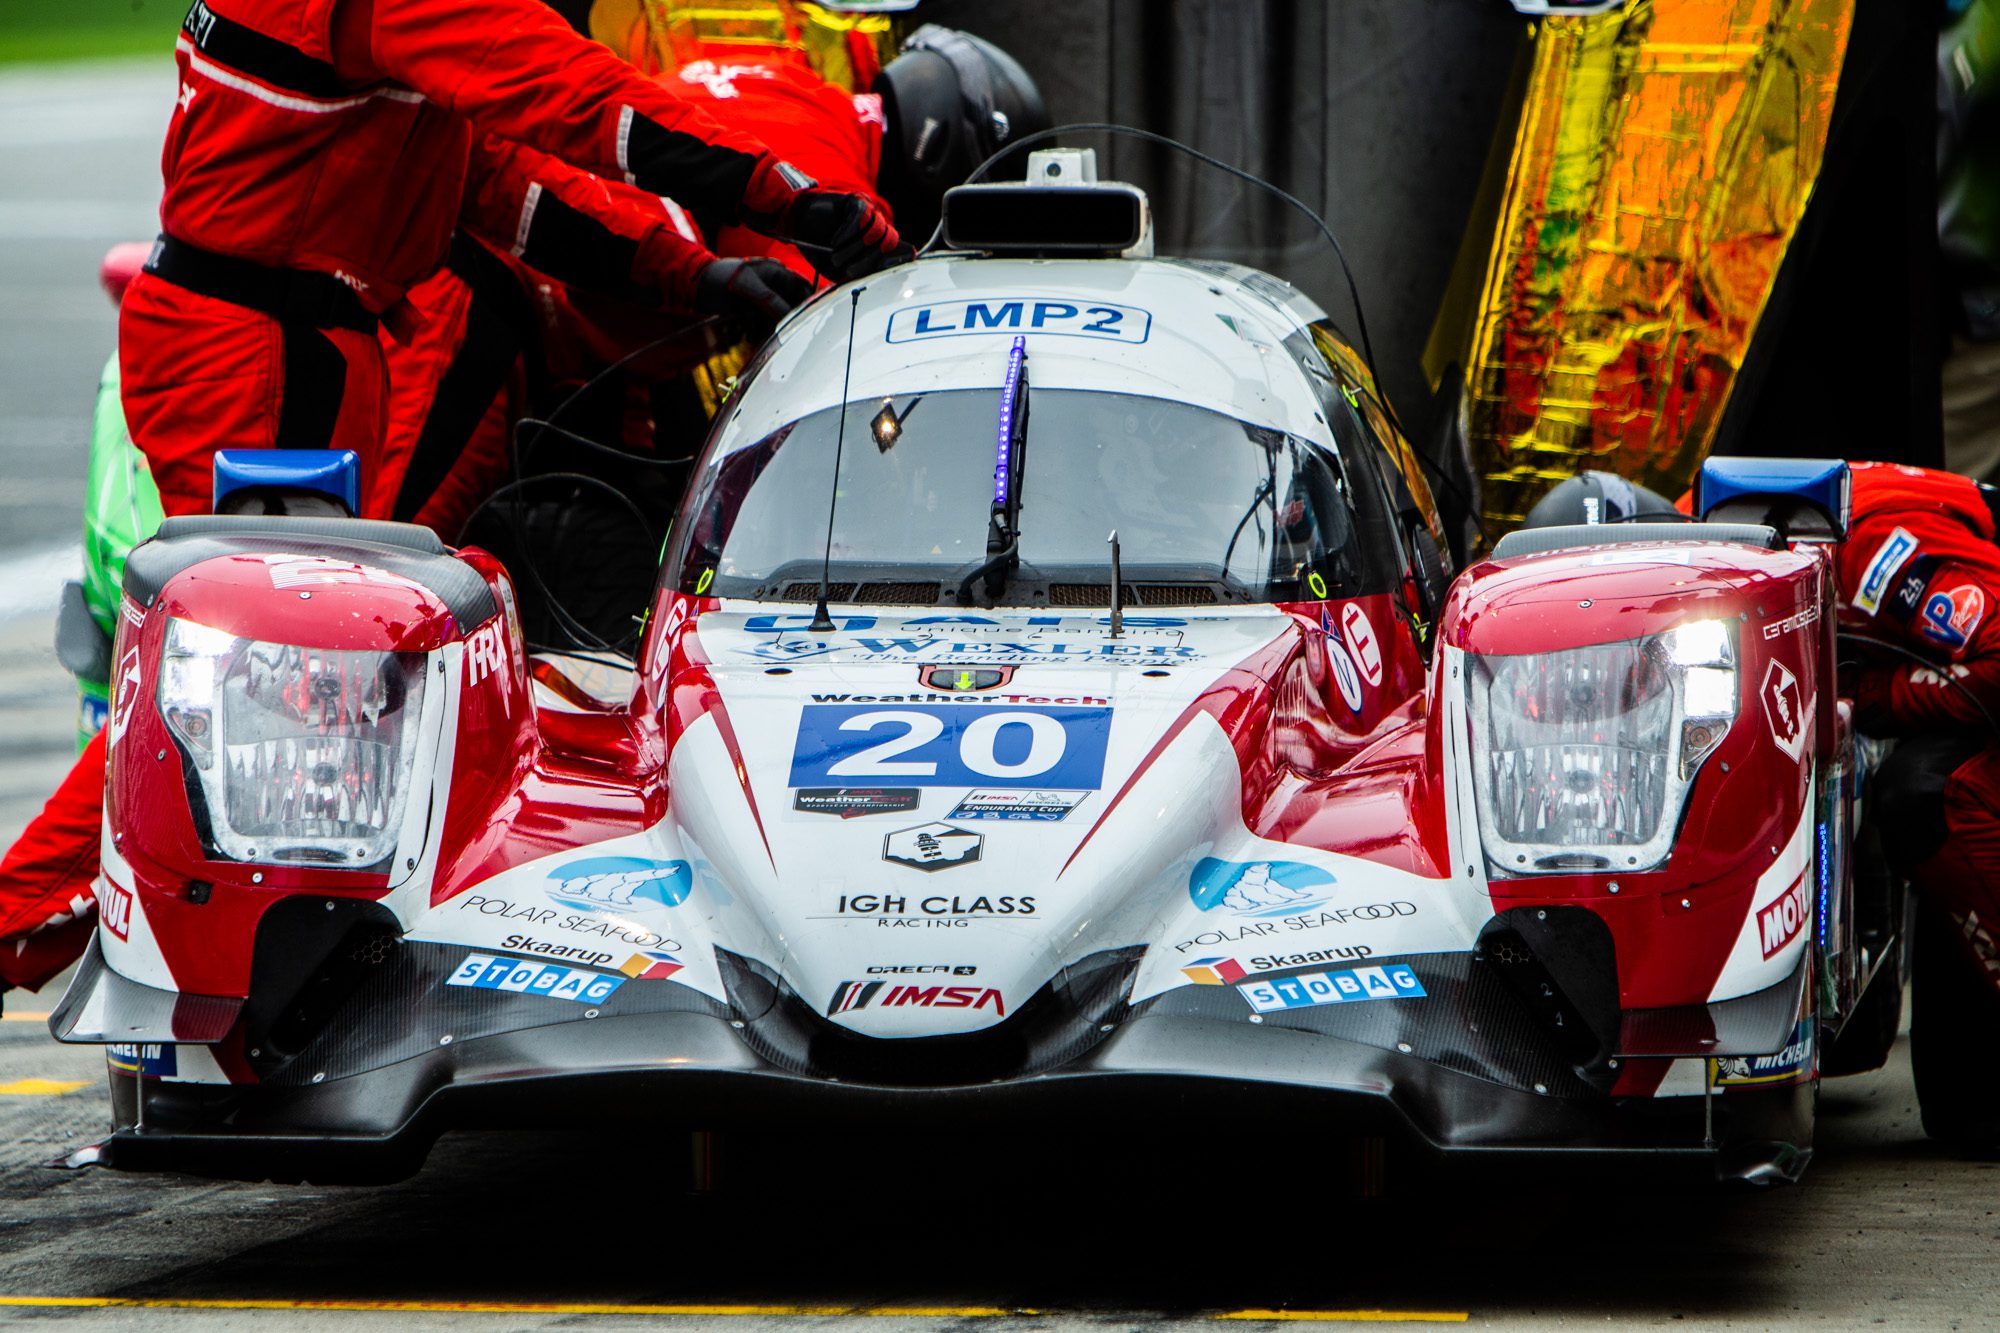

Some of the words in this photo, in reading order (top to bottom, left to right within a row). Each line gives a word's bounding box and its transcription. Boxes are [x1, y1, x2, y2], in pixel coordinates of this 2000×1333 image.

[914, 302, 1124, 335] LMP2
[1345, 609, 1381, 680] E
[811, 693, 1108, 706] WeatherTech
[826, 711, 1067, 779] 20
[963, 804, 1036, 812] ENDURANCE
[1038, 805, 1065, 813] CUP
[838, 895, 906, 914] IGH
[920, 896, 1037, 915] CLASS
[460, 895, 558, 924] POLAR
[558, 915, 683, 952] SEAFOOD
[877, 918, 969, 928] RACING
[1174, 921, 1280, 954] POLAR
[1283, 901, 1418, 931] SEAFOOD
[500, 935, 614, 967] Skaarup
[1250, 943, 1373, 970] Skaarup
[458, 961, 616, 998] STOBAG
[866, 965, 950, 974] ORECA
[880, 985, 1005, 1018] IMSA
[1252, 970, 1417, 1004] STOBAG
